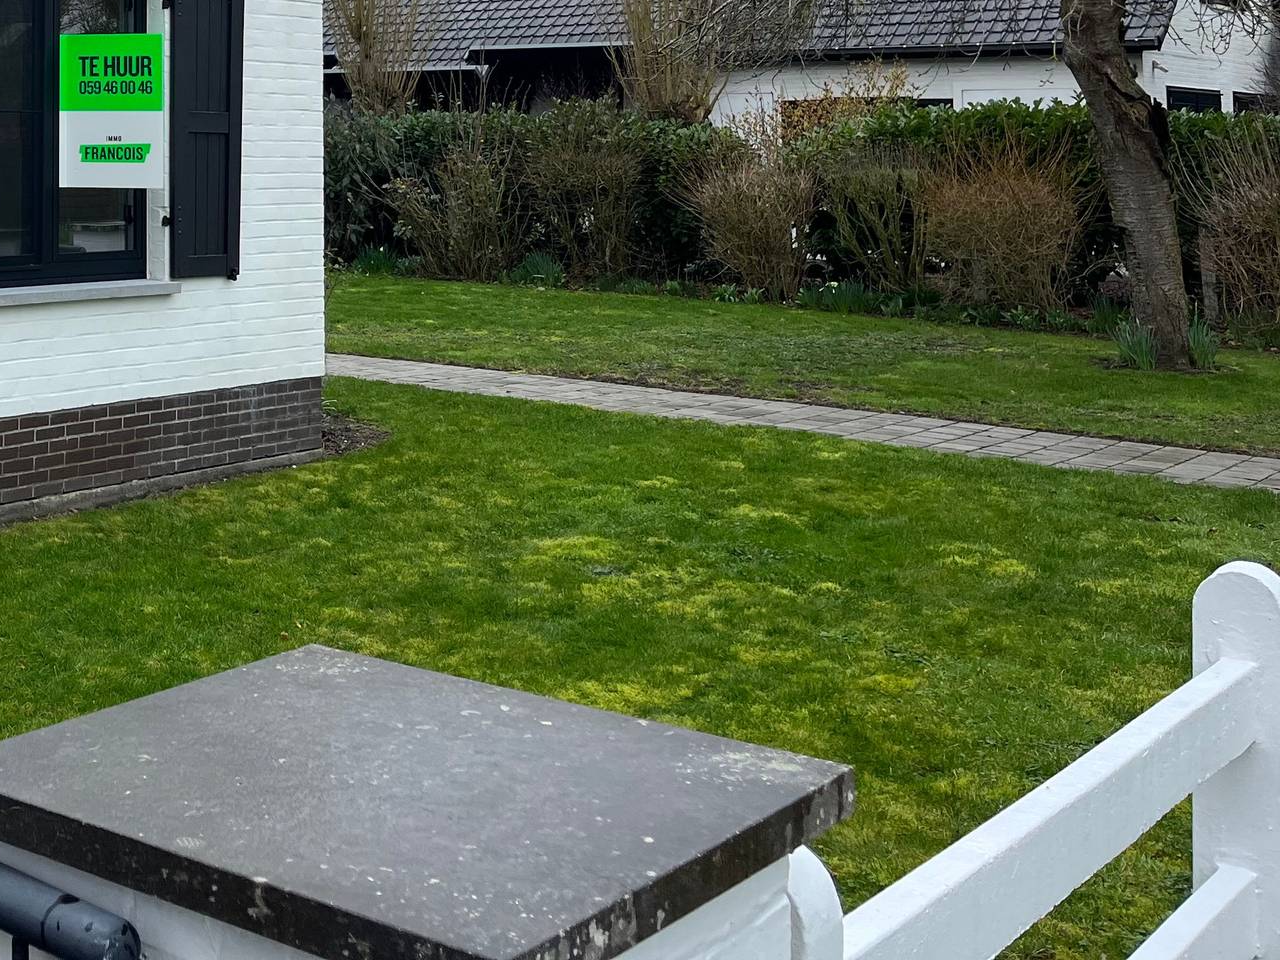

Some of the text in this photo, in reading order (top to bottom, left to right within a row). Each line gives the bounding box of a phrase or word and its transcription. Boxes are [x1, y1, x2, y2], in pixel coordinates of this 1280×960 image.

[79, 56, 152, 77] TE HUUR
[79, 80, 153, 95] 059 46 00 46
[85, 146, 144, 161] FRANCOIS
